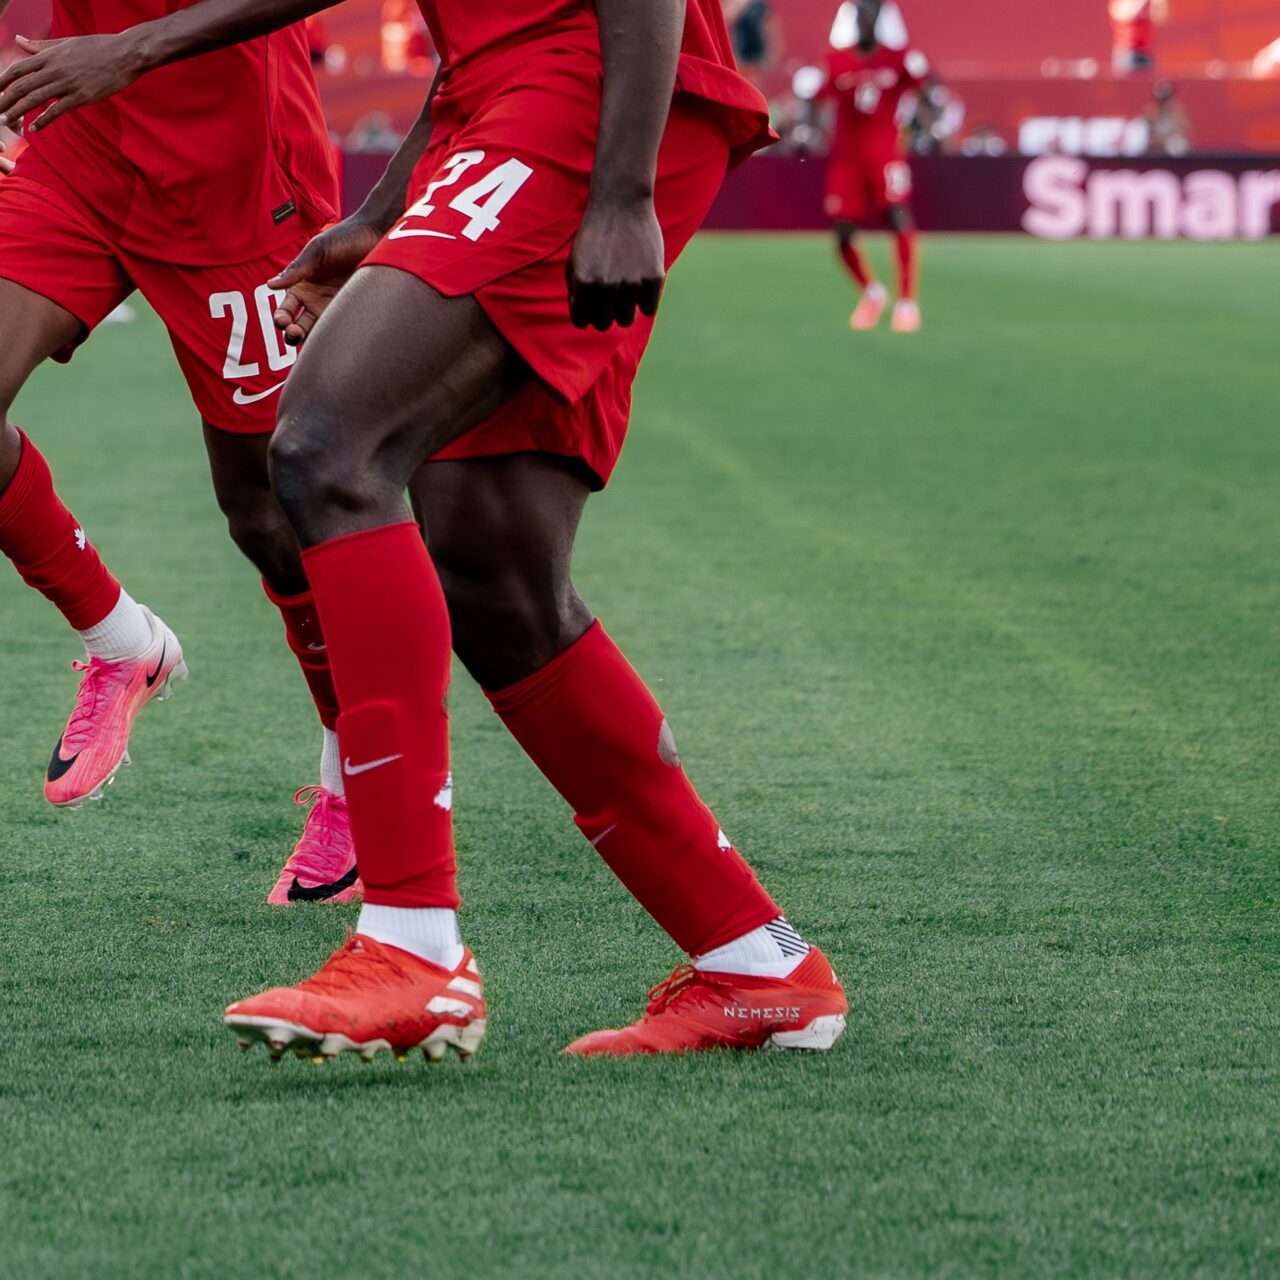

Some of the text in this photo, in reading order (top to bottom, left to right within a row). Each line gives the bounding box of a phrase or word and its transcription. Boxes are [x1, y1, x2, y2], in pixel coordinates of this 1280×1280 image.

[403, 149, 534, 242] 24
[208, 284, 297, 379] 20
[724, 1002, 800, 1018] NEMESIS
